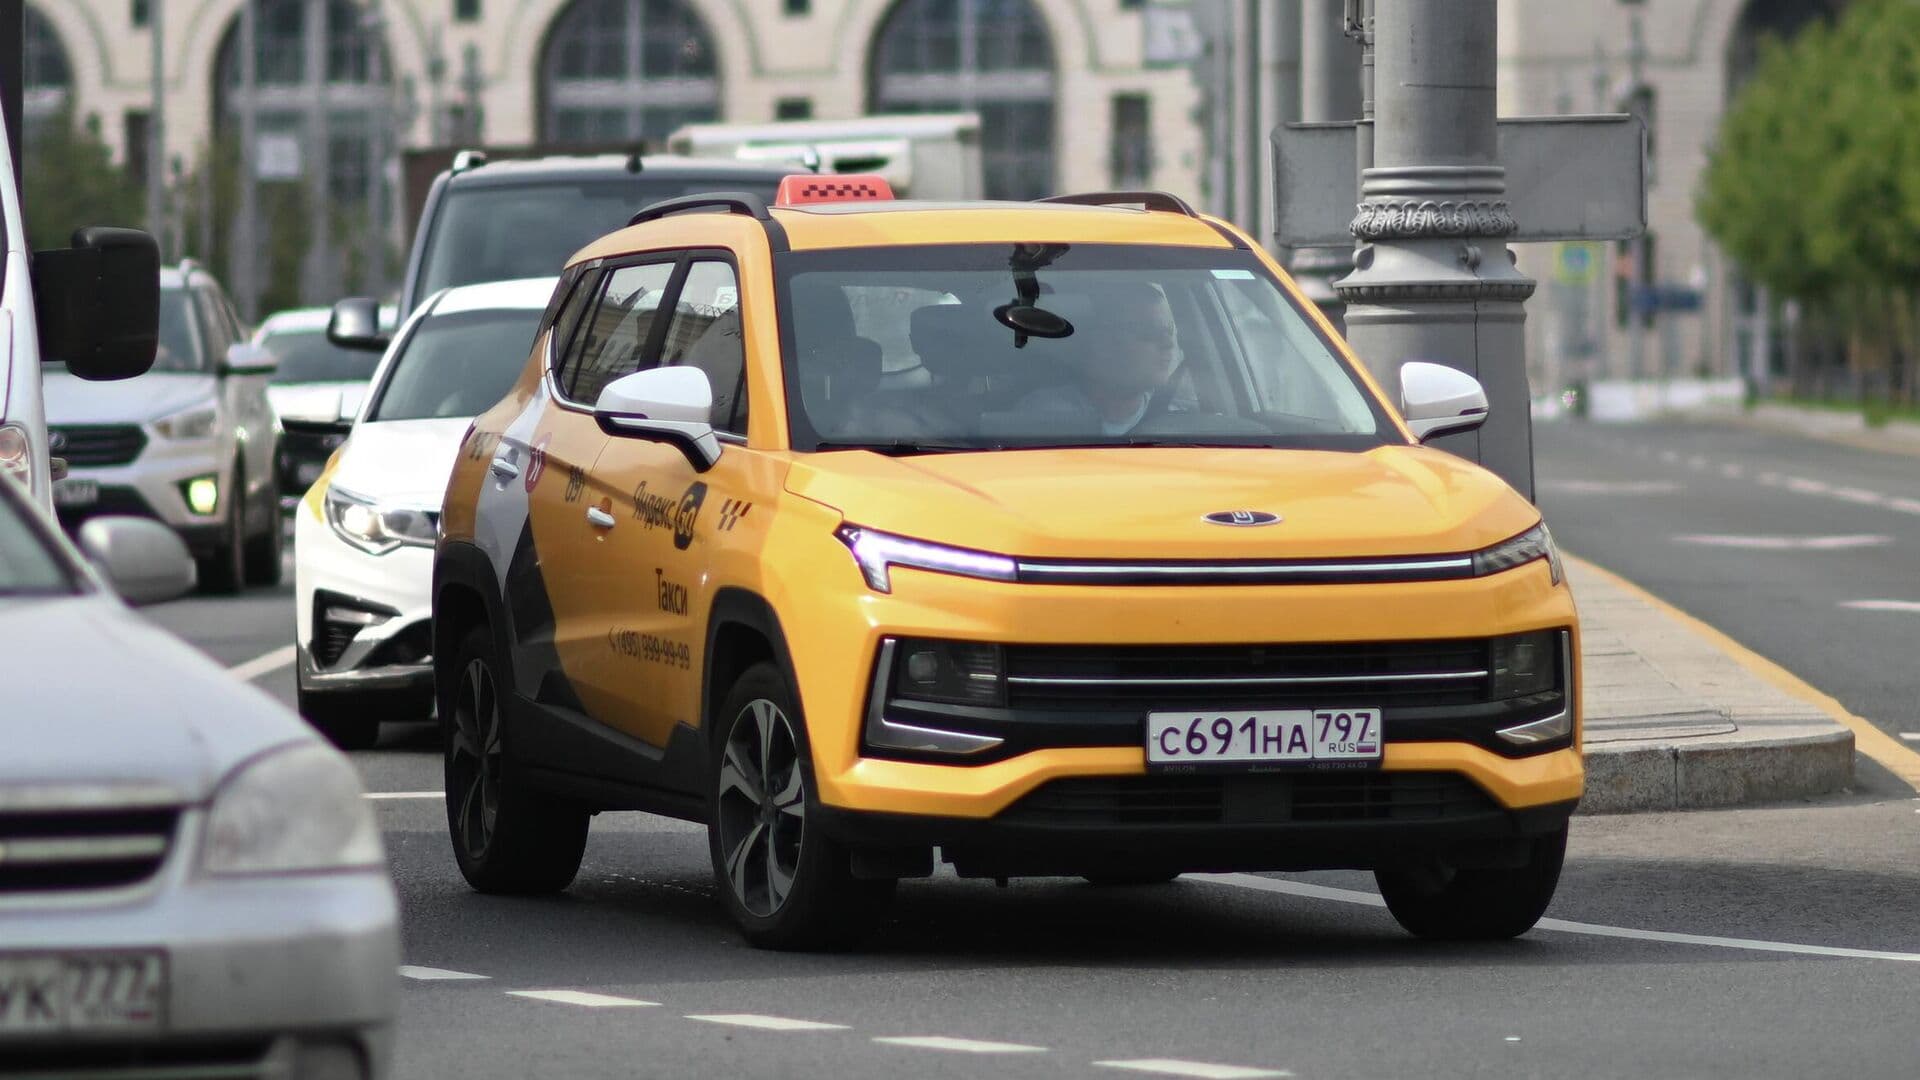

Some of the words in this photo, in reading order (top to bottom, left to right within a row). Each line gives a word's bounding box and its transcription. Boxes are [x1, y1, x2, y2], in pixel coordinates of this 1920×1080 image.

[633, 479, 676, 530] Яндекс
[655, 567, 688, 617] Такси
[640, 632, 690, 671] 999-99-99
[1316, 713, 1371, 743] 797
[1329, 743, 1355, 753] RUS
